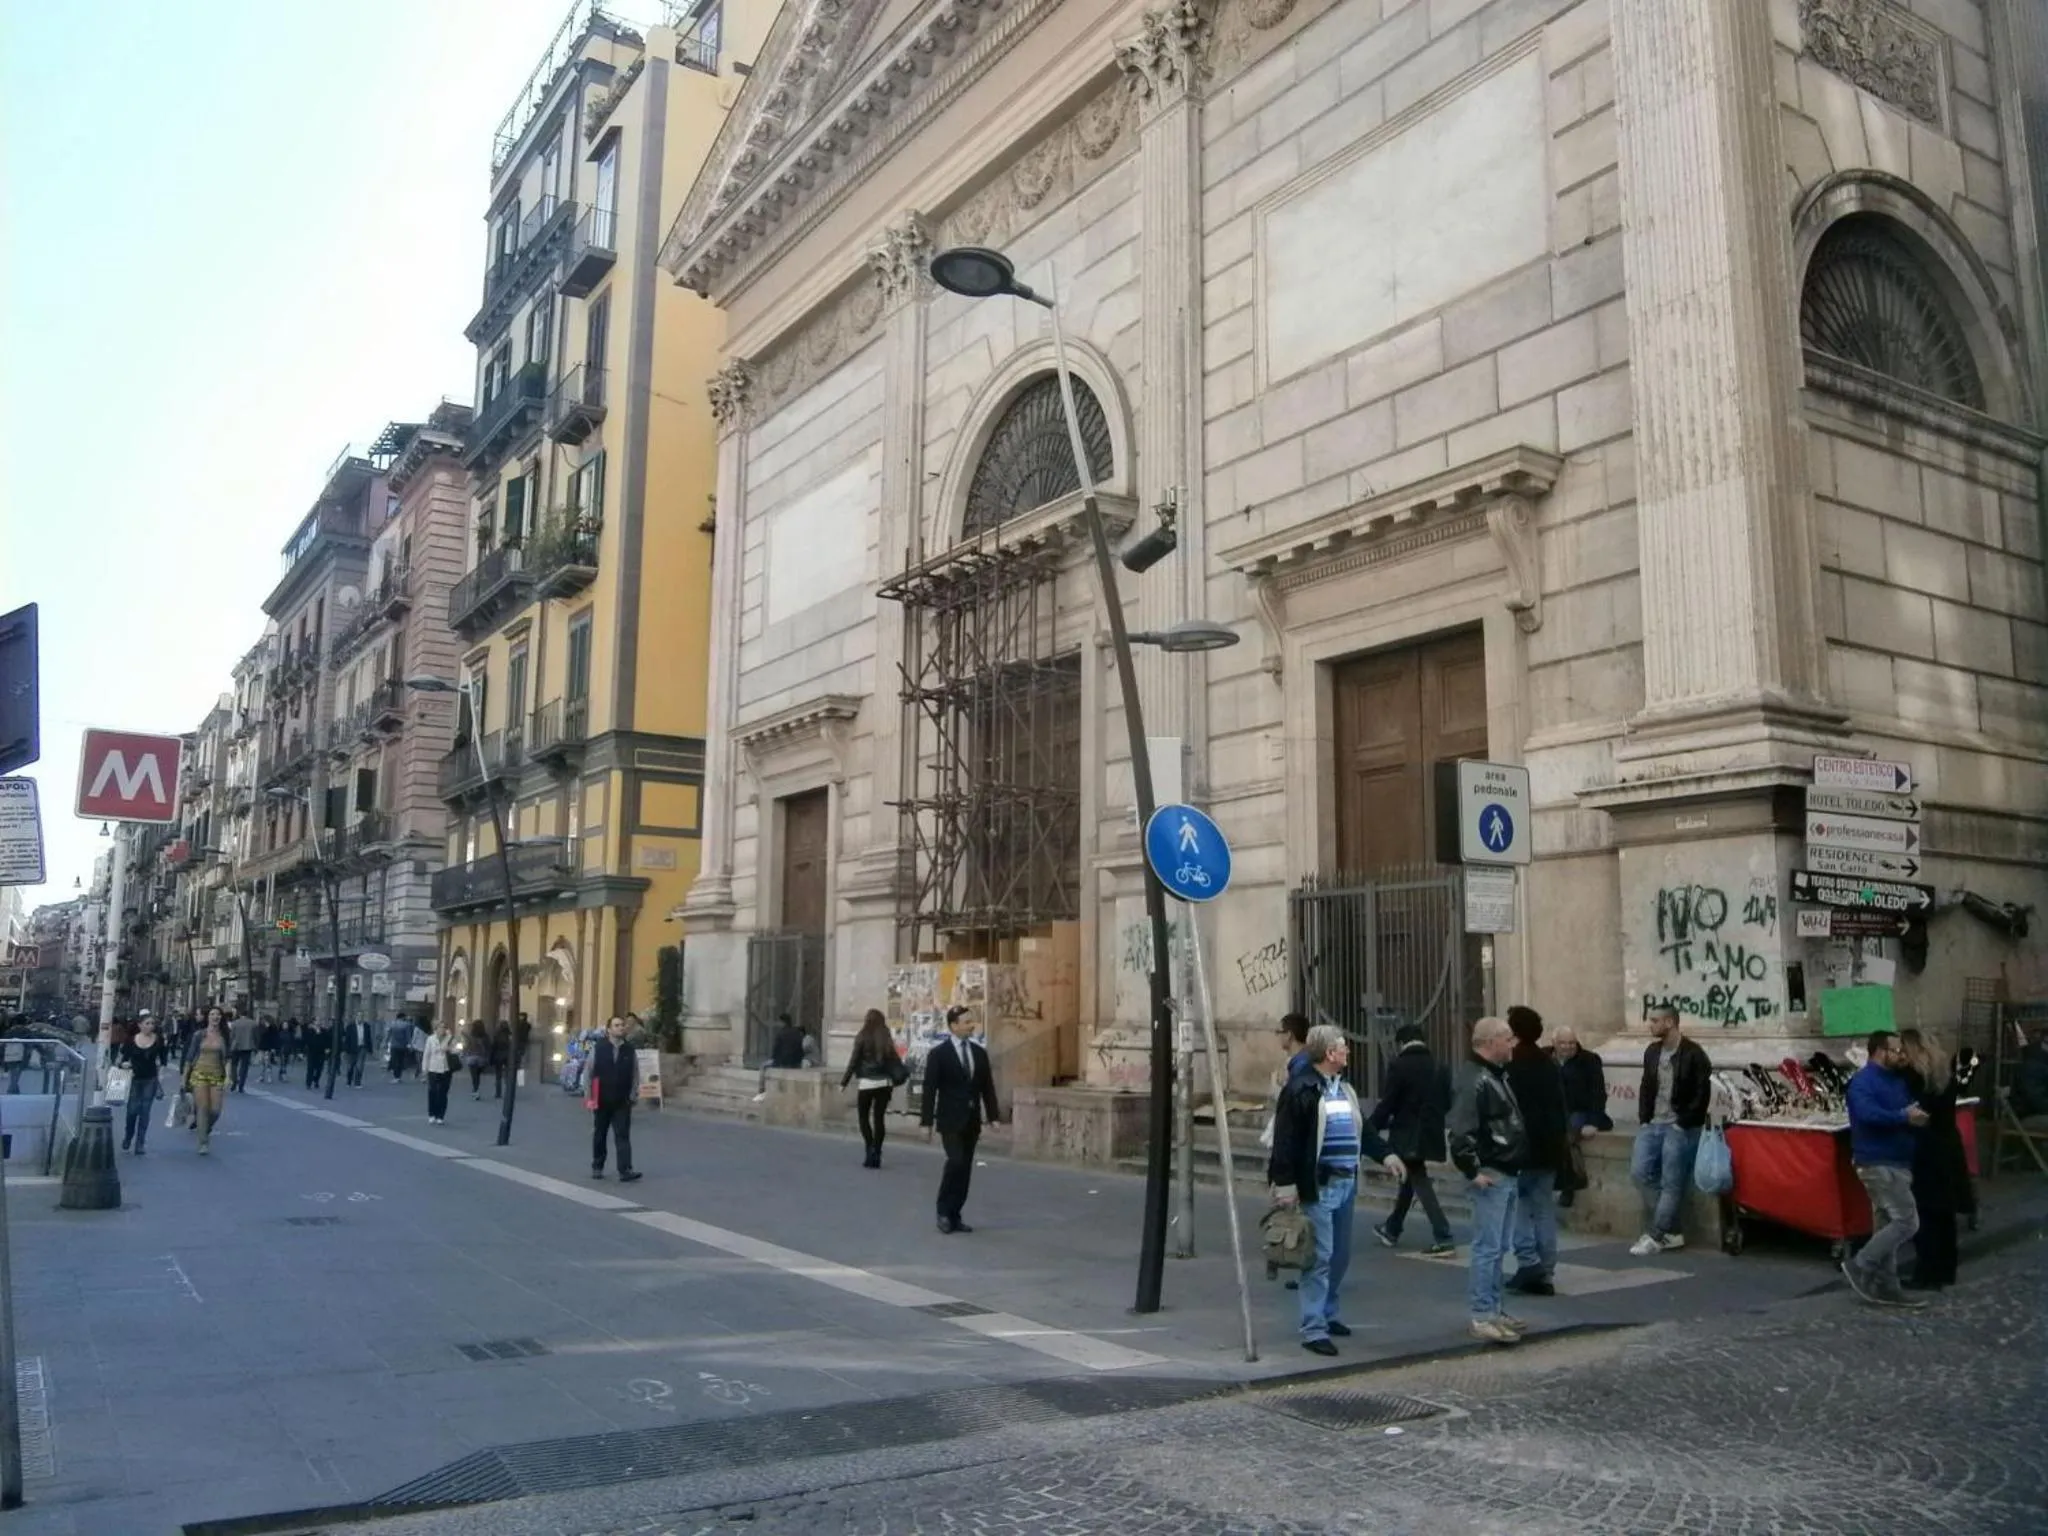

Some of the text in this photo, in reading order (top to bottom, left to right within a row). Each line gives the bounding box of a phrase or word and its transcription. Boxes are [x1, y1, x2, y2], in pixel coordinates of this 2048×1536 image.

[1817, 758, 1852, 774] CENTRO
[88, 750, 166, 804] M
[1485, 771, 1506, 782] area
[1474, 782, 1518, 798] pedonale
[1809, 793, 1886, 812] HOTEL TOLEDO
[1809, 847, 1876, 864] RESIDENCE
[1816, 860, 1836, 871] San
[1660, 940, 1767, 981] TI AMO
[1707, 984, 1739, 1009] BY
